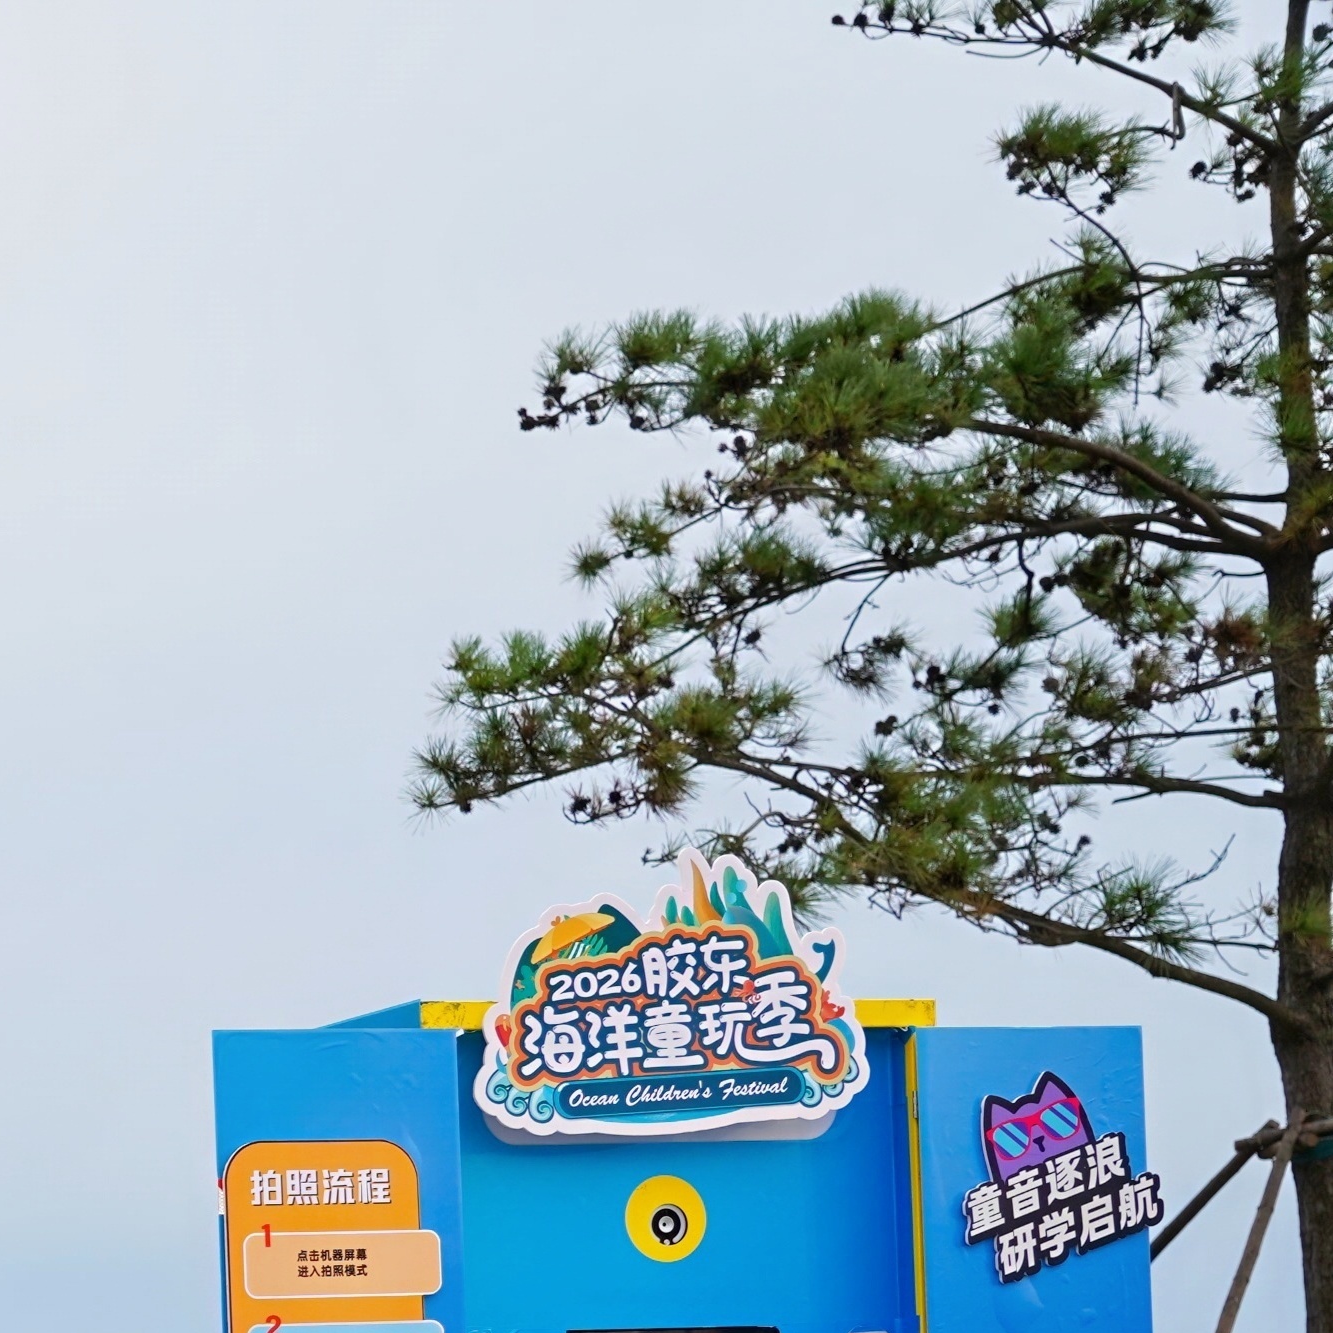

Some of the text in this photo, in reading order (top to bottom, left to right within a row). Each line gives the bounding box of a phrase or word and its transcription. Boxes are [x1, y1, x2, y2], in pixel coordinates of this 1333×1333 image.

[548, 935, 750, 1002] 2026胶东
[520, 971, 836, 1076] 海洋童玩季
[568, 1076, 789, 1108] Ocean Children's Festival
[250, 1168, 392, 1206] 拍照流程
[967, 1136, 1126, 1236] 童音逐浪
[261, 1224, 272, 1247] 1
[998, 1176, 1160, 1277] 研学启航
[296, 1248, 368, 1263] 点击机器屏幕
[297, 1263, 368, 1278] 进入拍照模式
